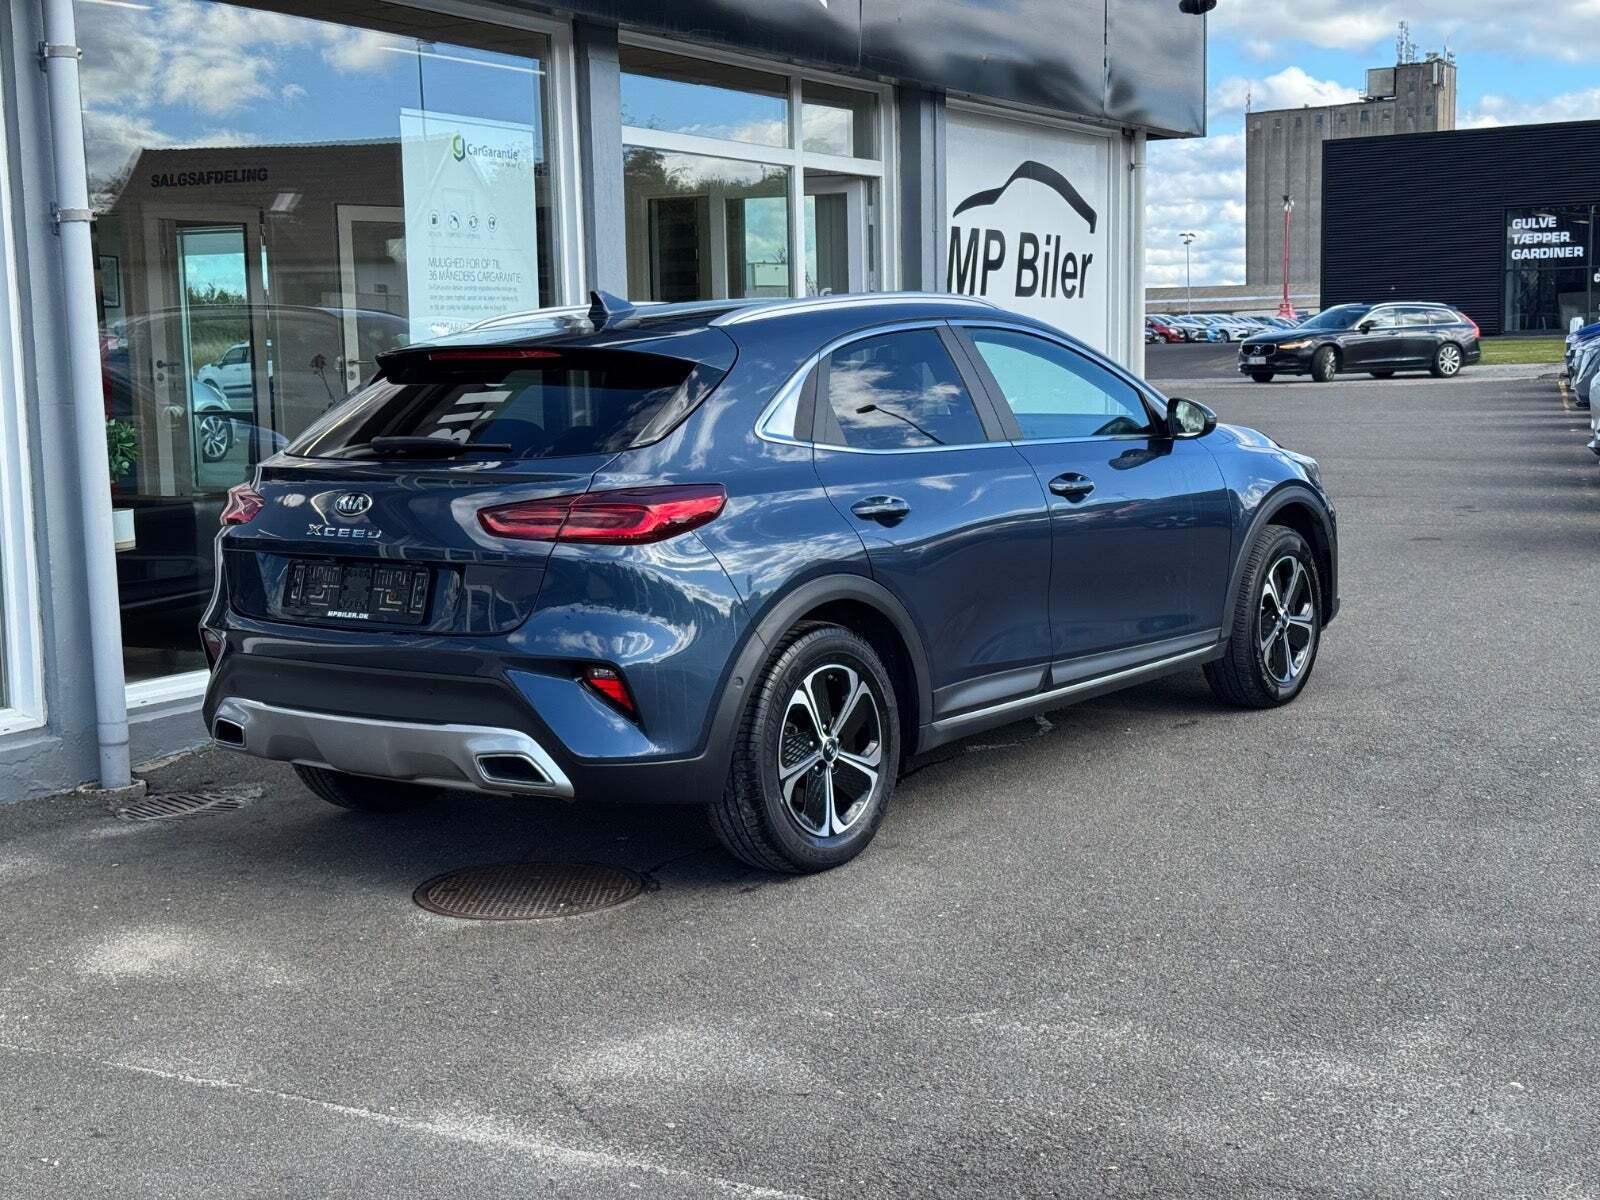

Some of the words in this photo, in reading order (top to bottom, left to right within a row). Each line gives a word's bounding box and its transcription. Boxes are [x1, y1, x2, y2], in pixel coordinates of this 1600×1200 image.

[150, 167, 269, 188] SALGSAFDELING
[1511, 216, 1557, 230] GULVE
[1511, 231, 1570, 245] TÆPPER
[1511, 246, 1584, 260] GARDINER
[946, 226, 1006, 297] MP
[1015, 231, 1093, 299] Biler
[428, 270, 437, 281] 36
[338, 495, 364, 510] KIA
[306, 523, 382, 539] XCEED
